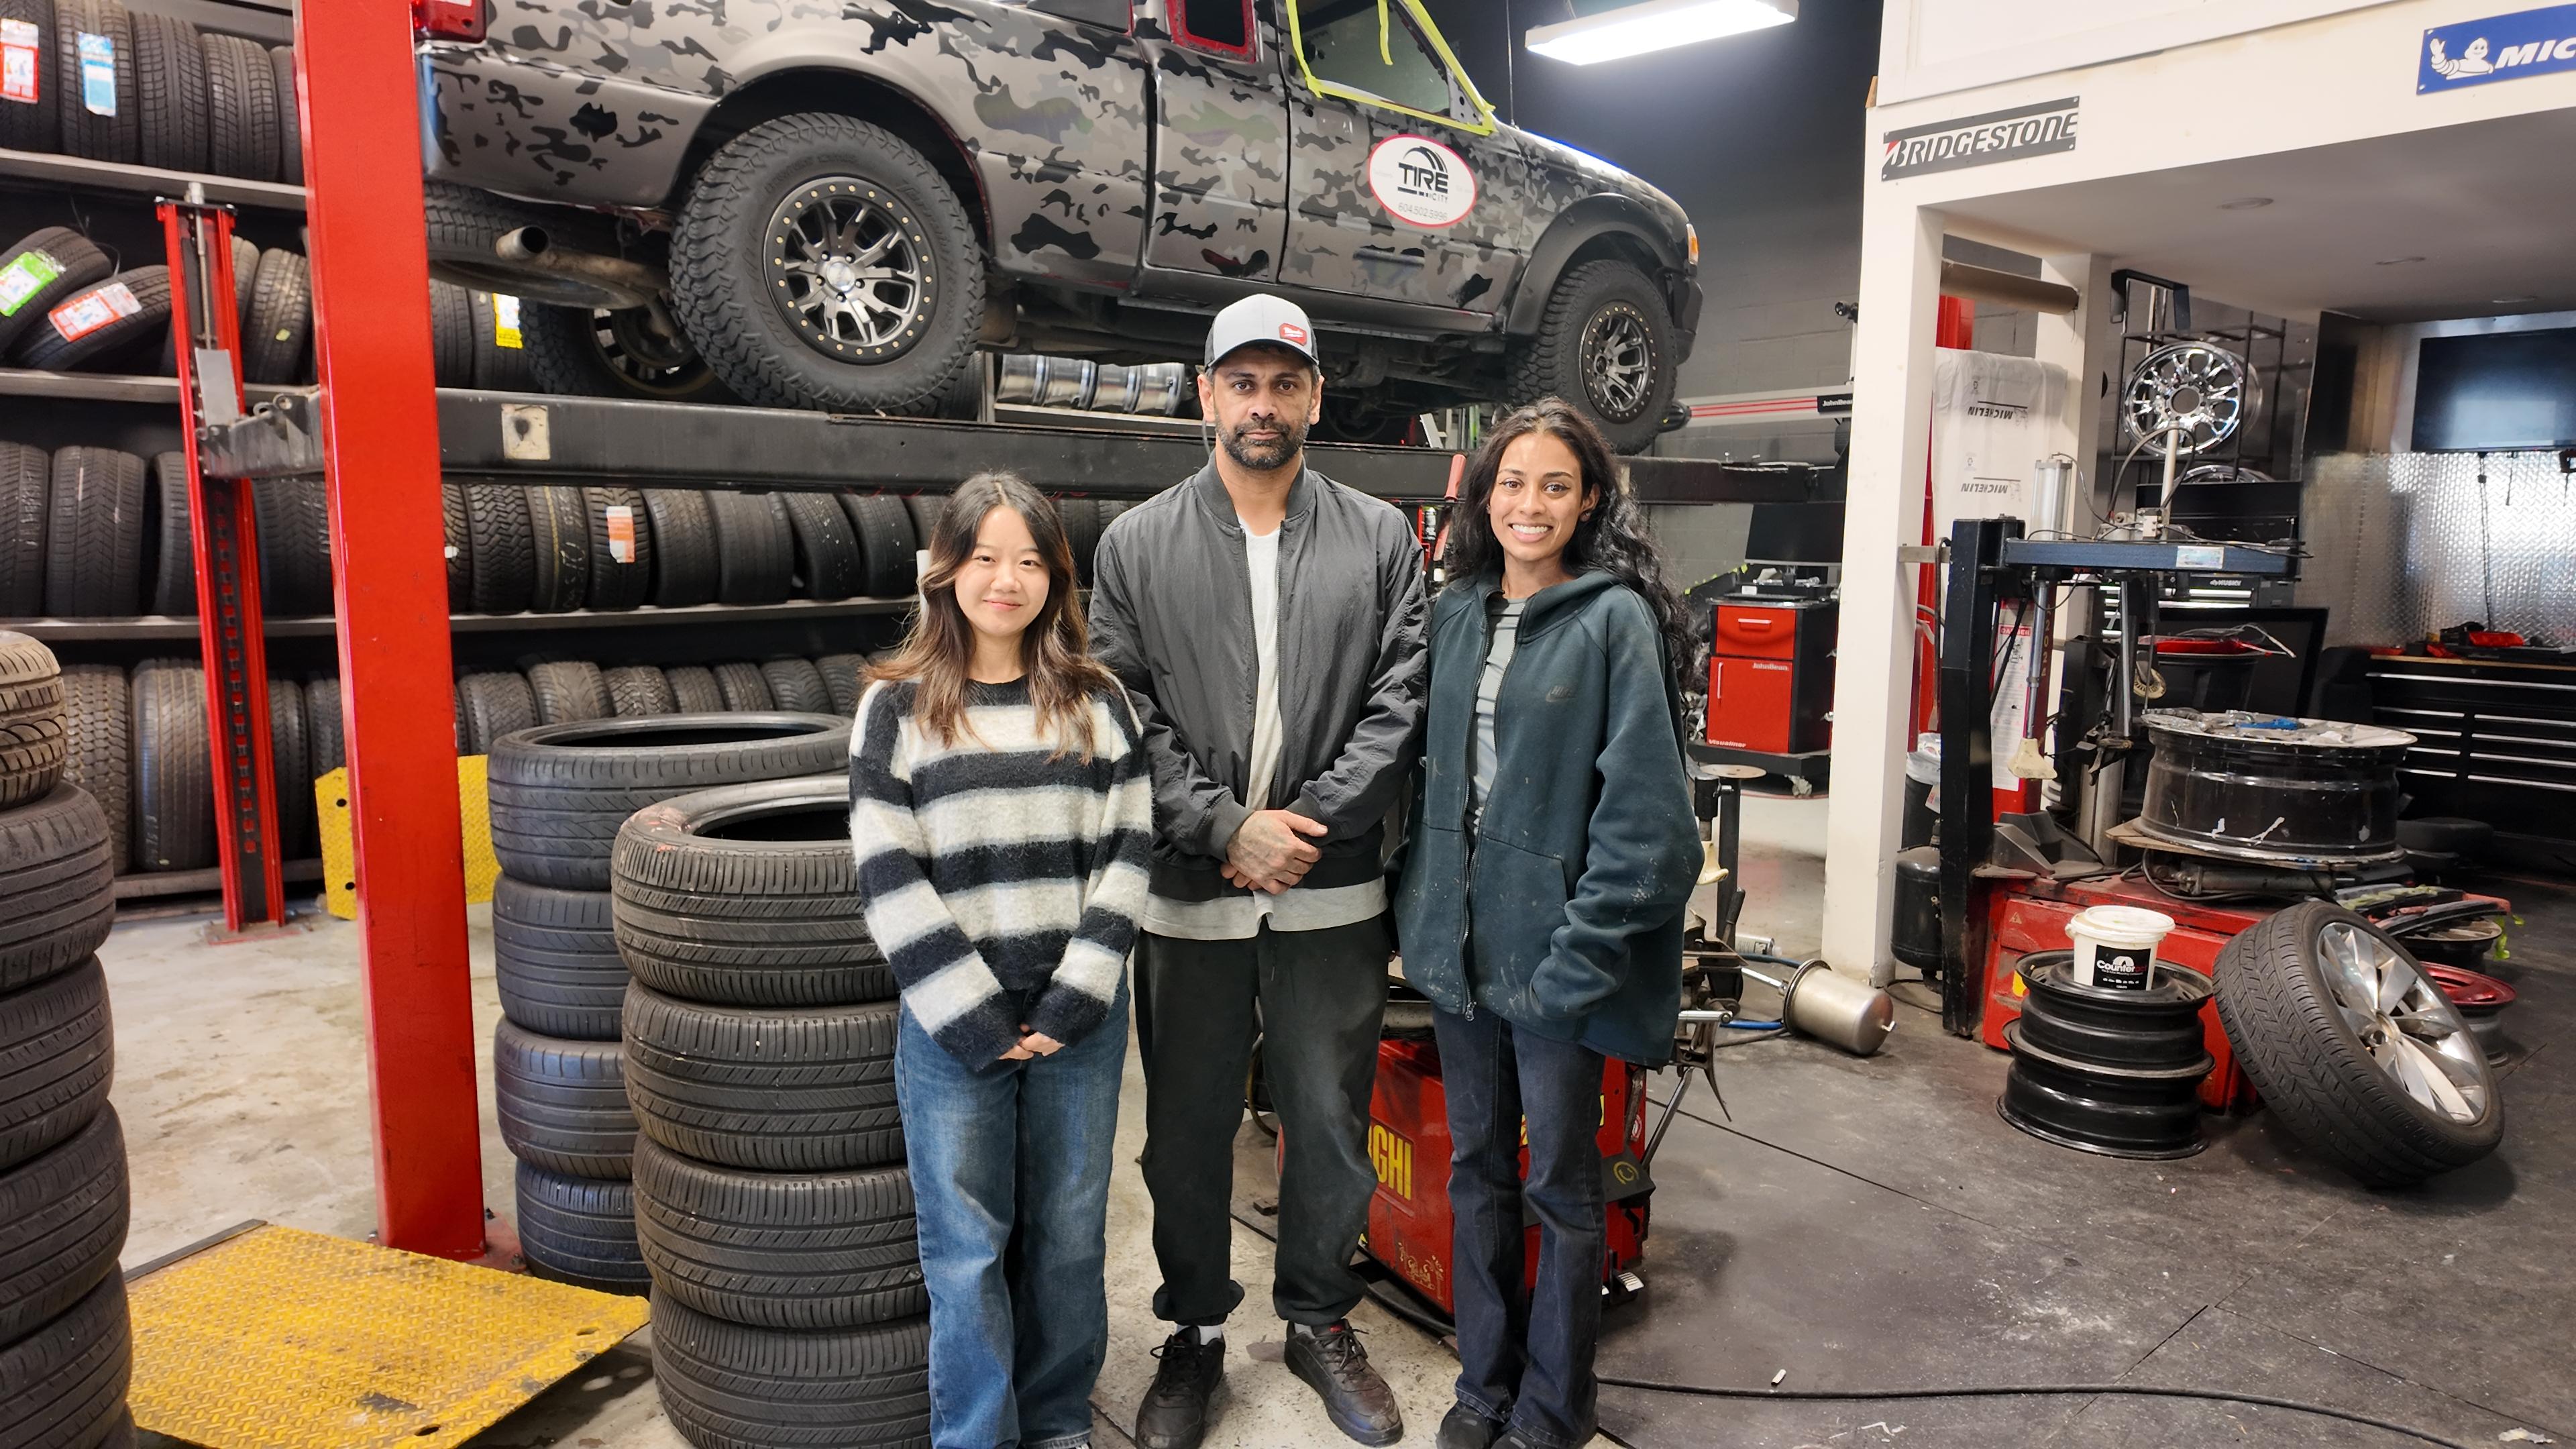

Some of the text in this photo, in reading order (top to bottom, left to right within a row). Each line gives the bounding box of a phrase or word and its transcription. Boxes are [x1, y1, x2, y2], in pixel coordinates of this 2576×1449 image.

[1882, 111, 2078, 168] BRIDGESTONE
[1398, 162, 1449, 194] TIRE
[1432, 193, 1448, 204] CITY
[1968, 407, 2013, 419] MICHELIN
[1752, 662, 1789, 671] JohnBean
